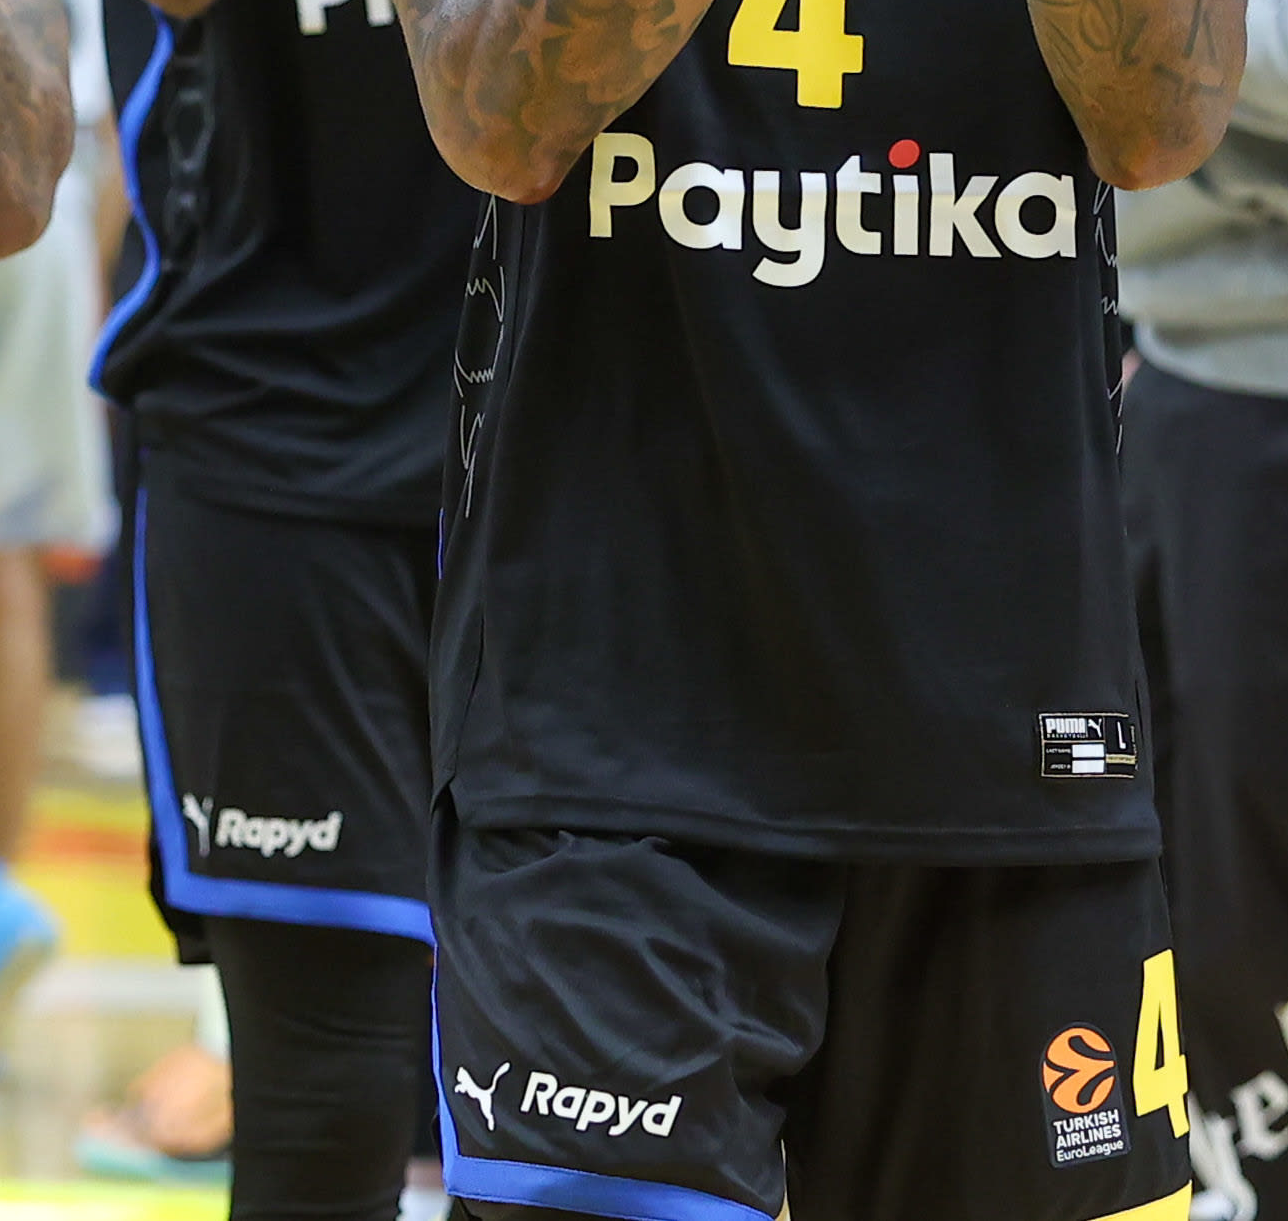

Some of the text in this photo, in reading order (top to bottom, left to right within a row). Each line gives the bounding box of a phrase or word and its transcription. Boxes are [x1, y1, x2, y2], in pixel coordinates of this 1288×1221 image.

[589, 132, 1078, 288] Paytika
[1045, 718, 1087, 734] PUMA
[214, 807, 344, 858] Rapyd
[1133, 948, 1191, 1139] 4
[520, 1071, 683, 1137] Rapyd
[1053, 1109, 1120, 1134] TURKISH
[1056, 1124, 1122, 1149] AIRLINES
[1056, 1140, 1124, 1162] EuroLeague
